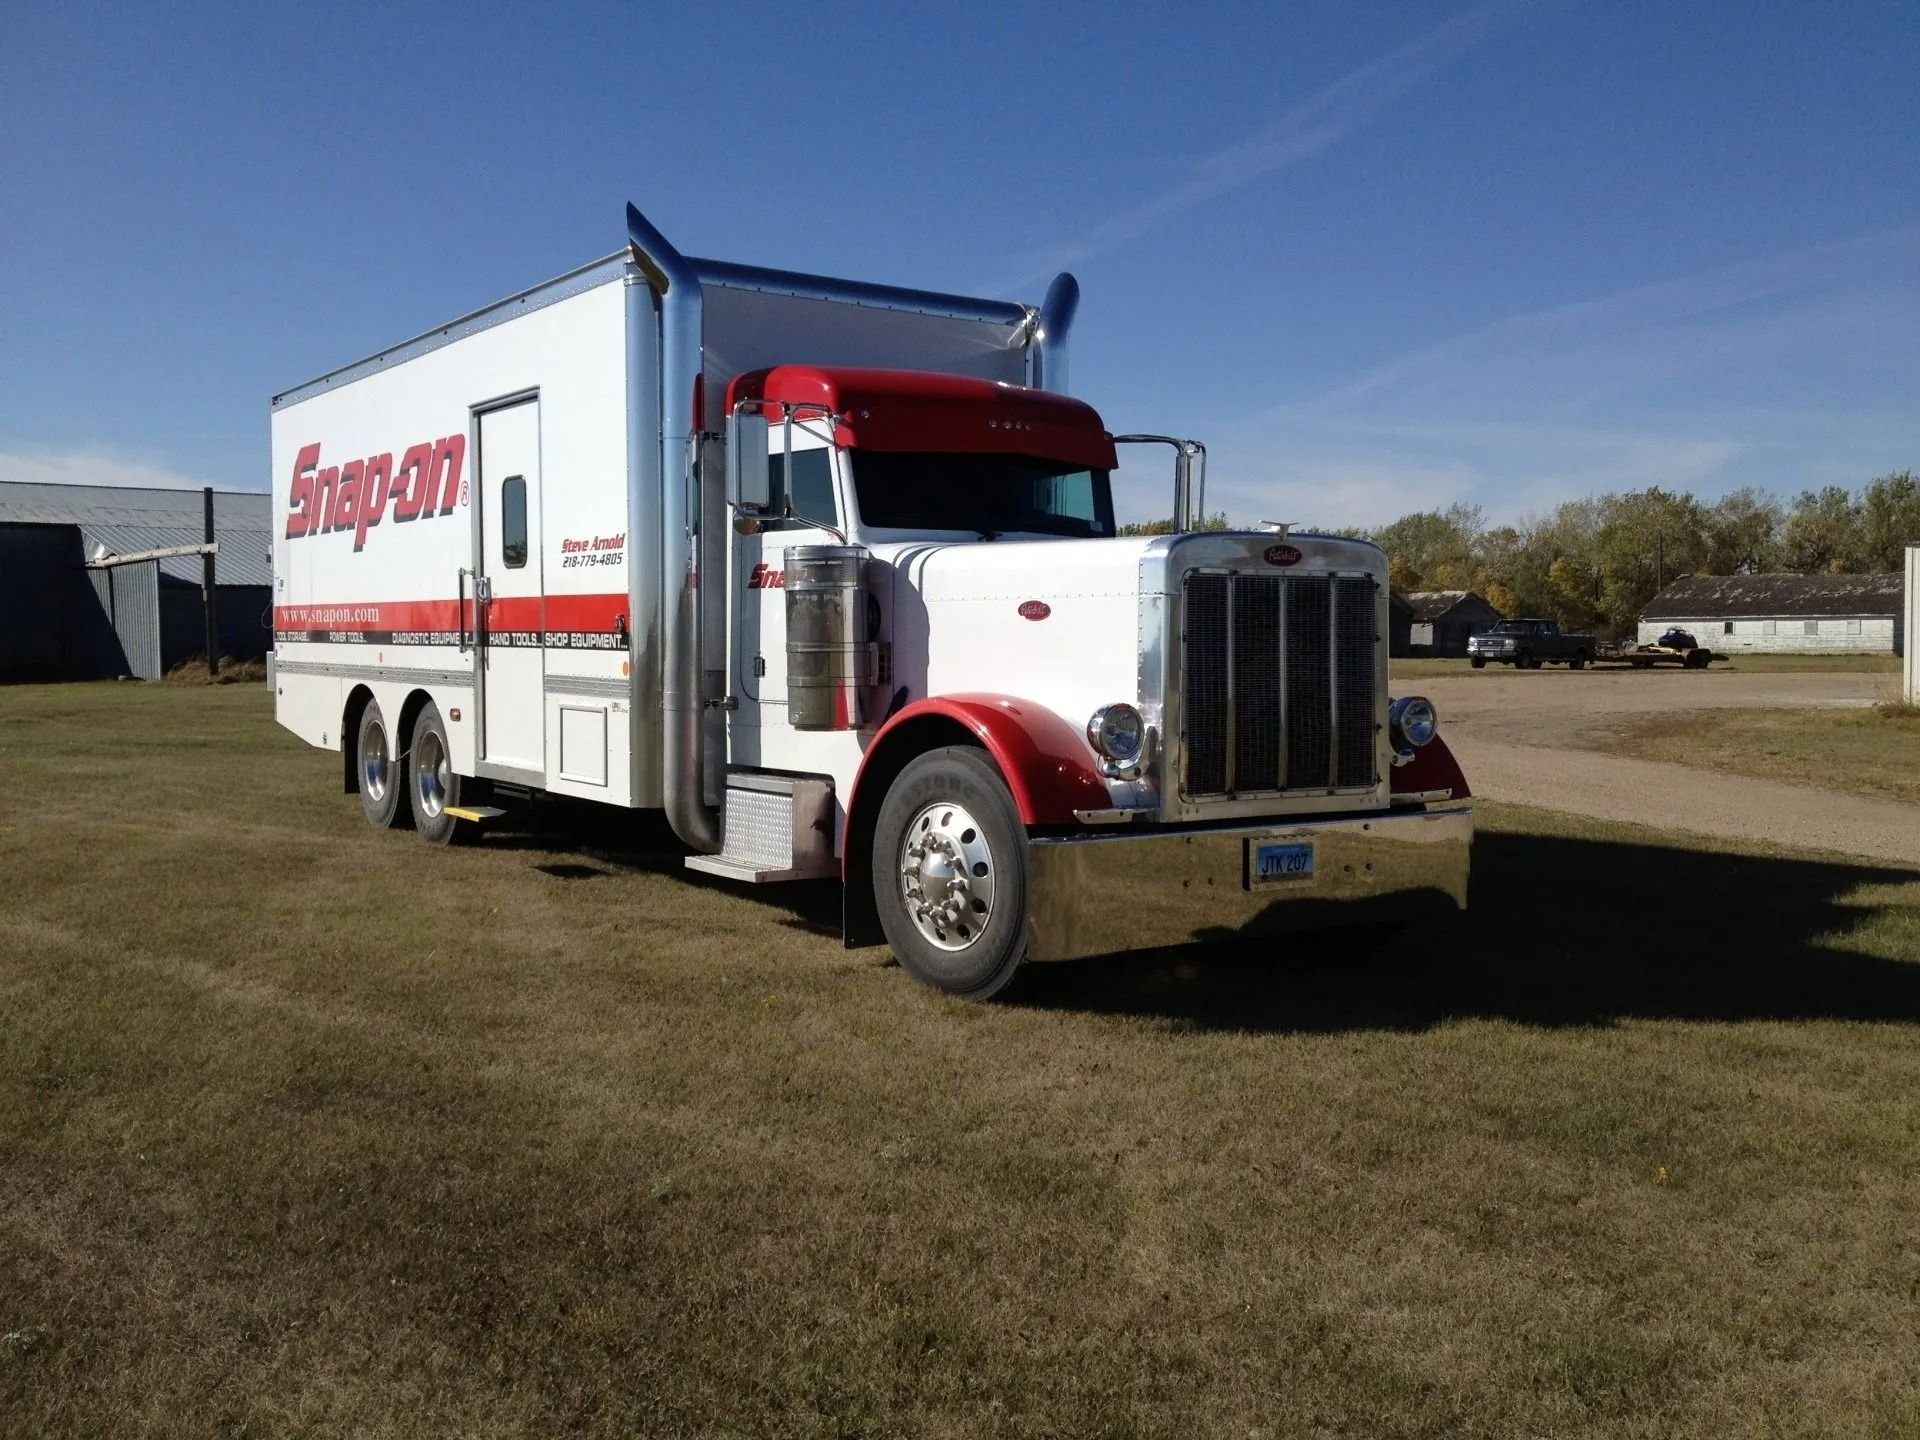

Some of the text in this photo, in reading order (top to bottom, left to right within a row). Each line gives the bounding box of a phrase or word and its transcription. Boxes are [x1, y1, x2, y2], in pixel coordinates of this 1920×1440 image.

[561, 532, 626, 553] Steve Arnold
[562, 552, 623, 568] 218-779-4805
[282, 607, 380, 628] www.snapon.com
[392, 632, 429, 644] DIAGNOSTIC
[489, 632, 510, 646] HAND
[545, 632, 569, 647] SHOP
[1262, 853, 1308, 873] JTK 207
